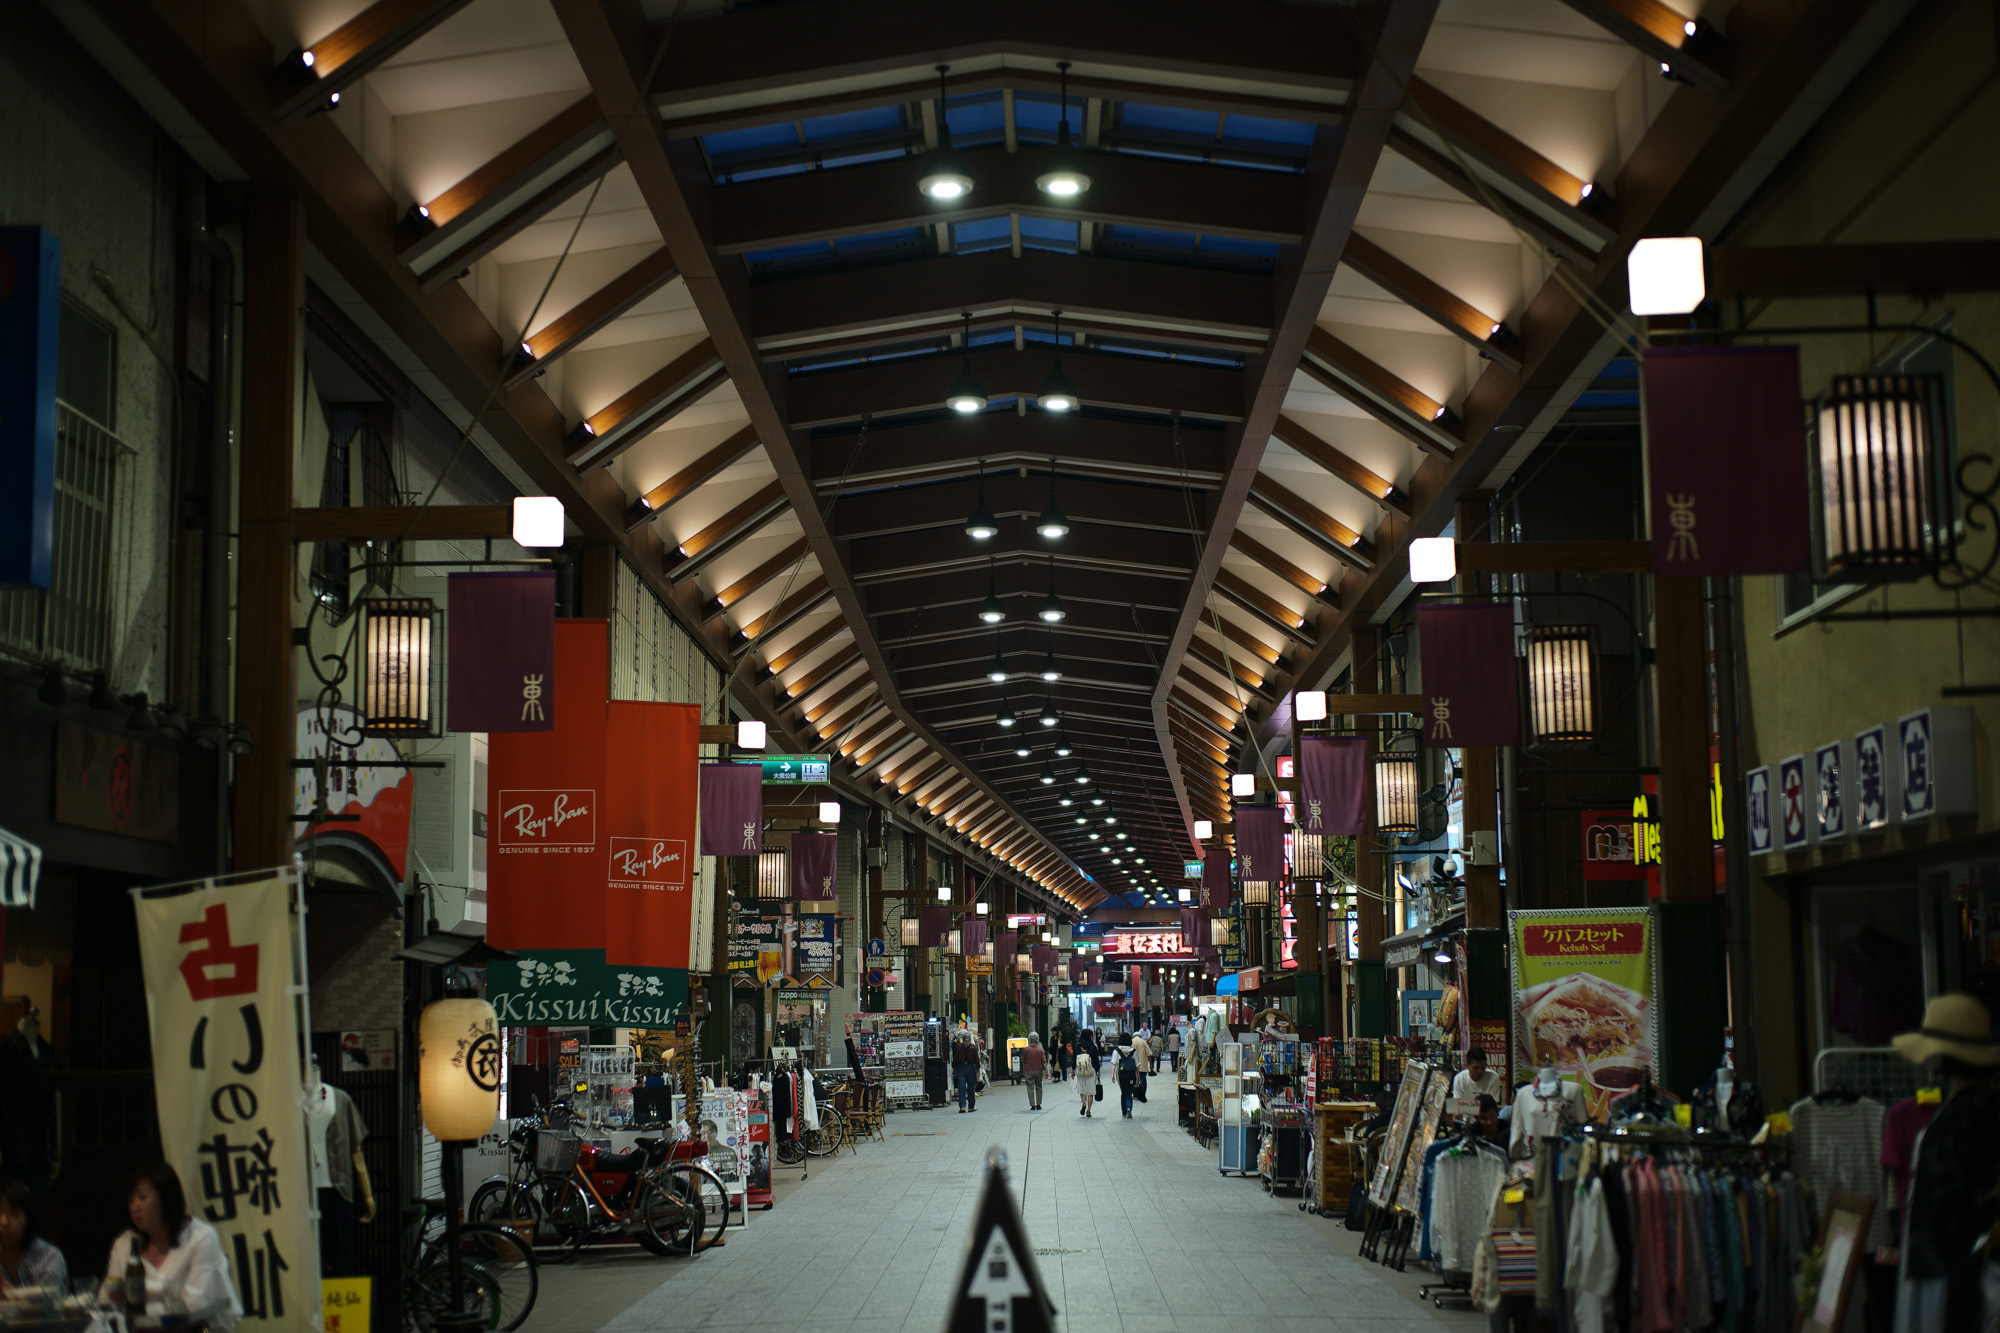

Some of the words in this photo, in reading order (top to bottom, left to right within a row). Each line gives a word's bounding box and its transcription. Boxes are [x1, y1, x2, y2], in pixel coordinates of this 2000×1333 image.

[499, 846, 540, 854] GENUINE
[542, 846, 571, 854] SINCE
[573, 846, 595, 854] 1937
[1542, 927, 1625, 943] ケバブセット
[1117, 932, 1193, 954] 東仁王門
[1559, 943, 1589, 953] Kebab
[1591, 943, 1606, 952] Set
[493, 991, 601, 1021] Kissui
[605, 1000, 683, 1025] Kissui
[559, 1054, 581, 1069] SALE
[1485, 1053, 1507, 1066] AND
[746, 1100, 764, 1111] ALE
